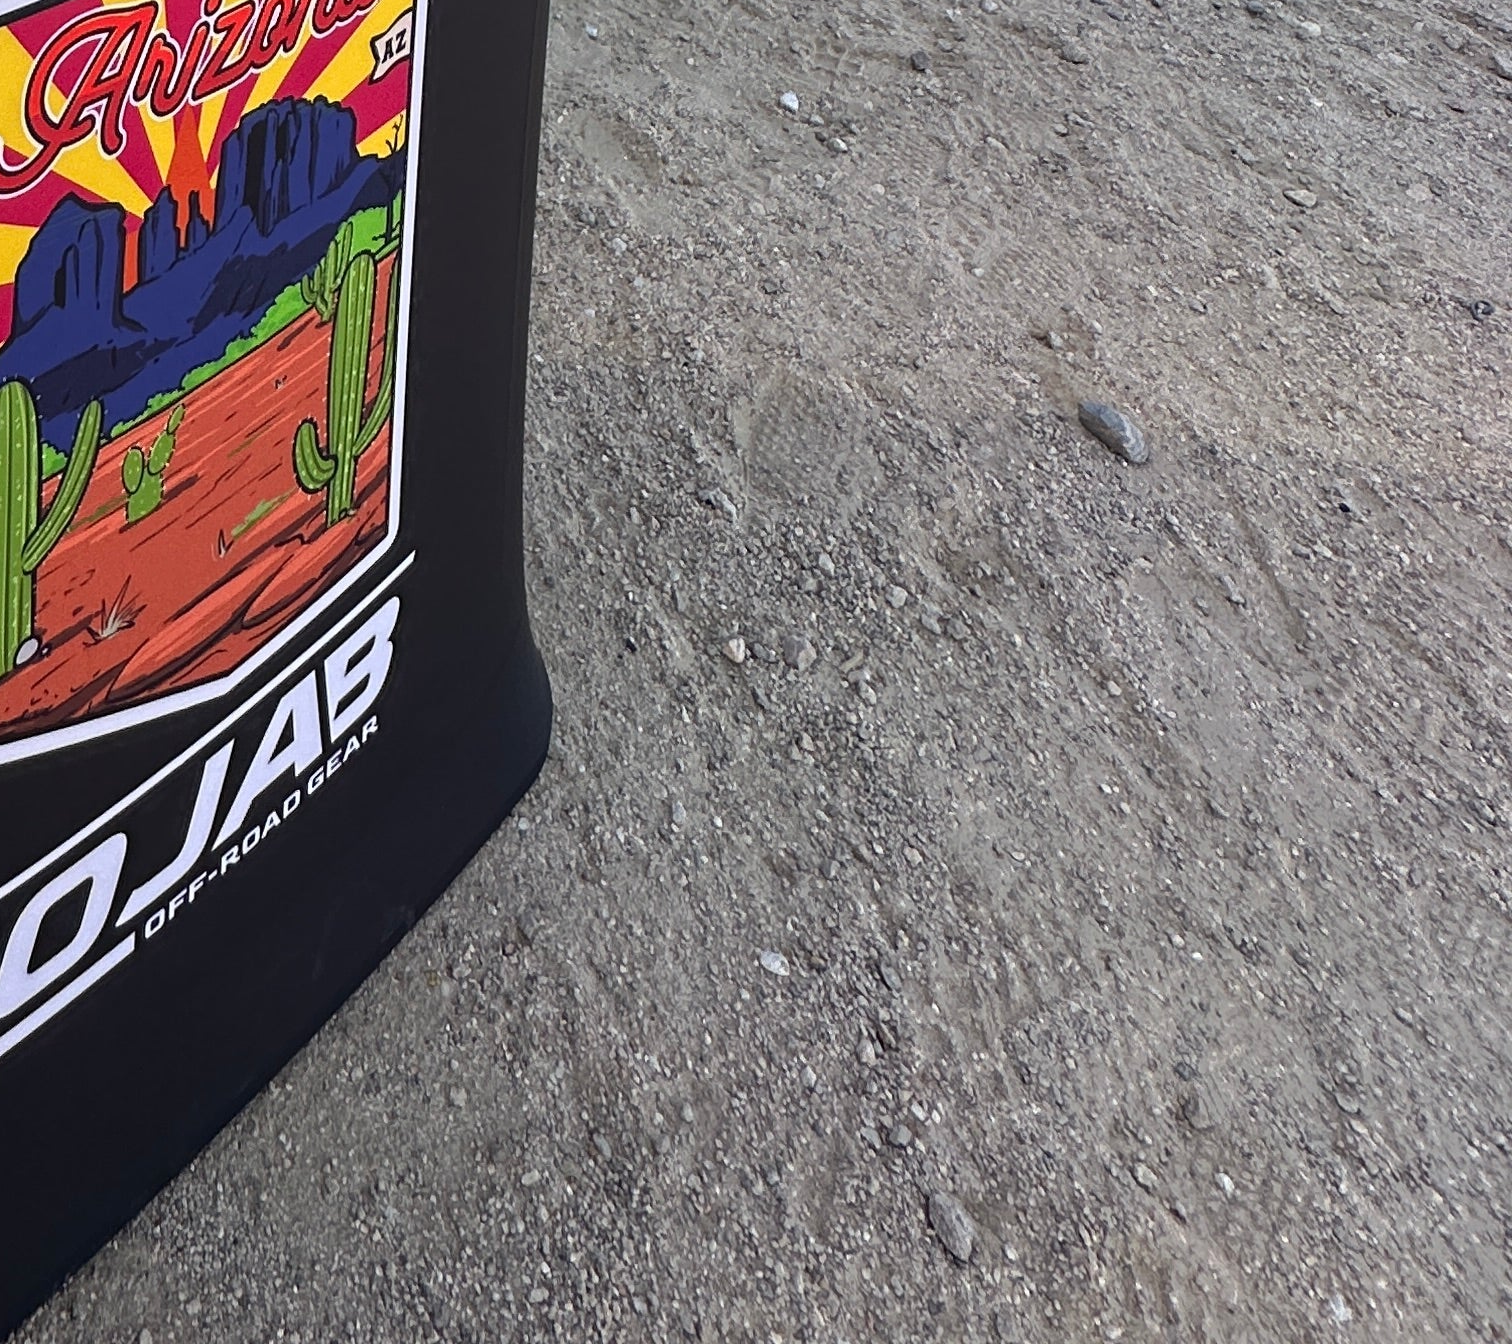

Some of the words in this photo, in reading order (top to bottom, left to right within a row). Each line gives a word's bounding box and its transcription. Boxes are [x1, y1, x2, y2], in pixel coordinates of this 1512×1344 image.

[381, 26, 407, 65] AZ
[144, 790, 301, 940] OFF-ROAD
[307, 715, 379, 796] GEAR
